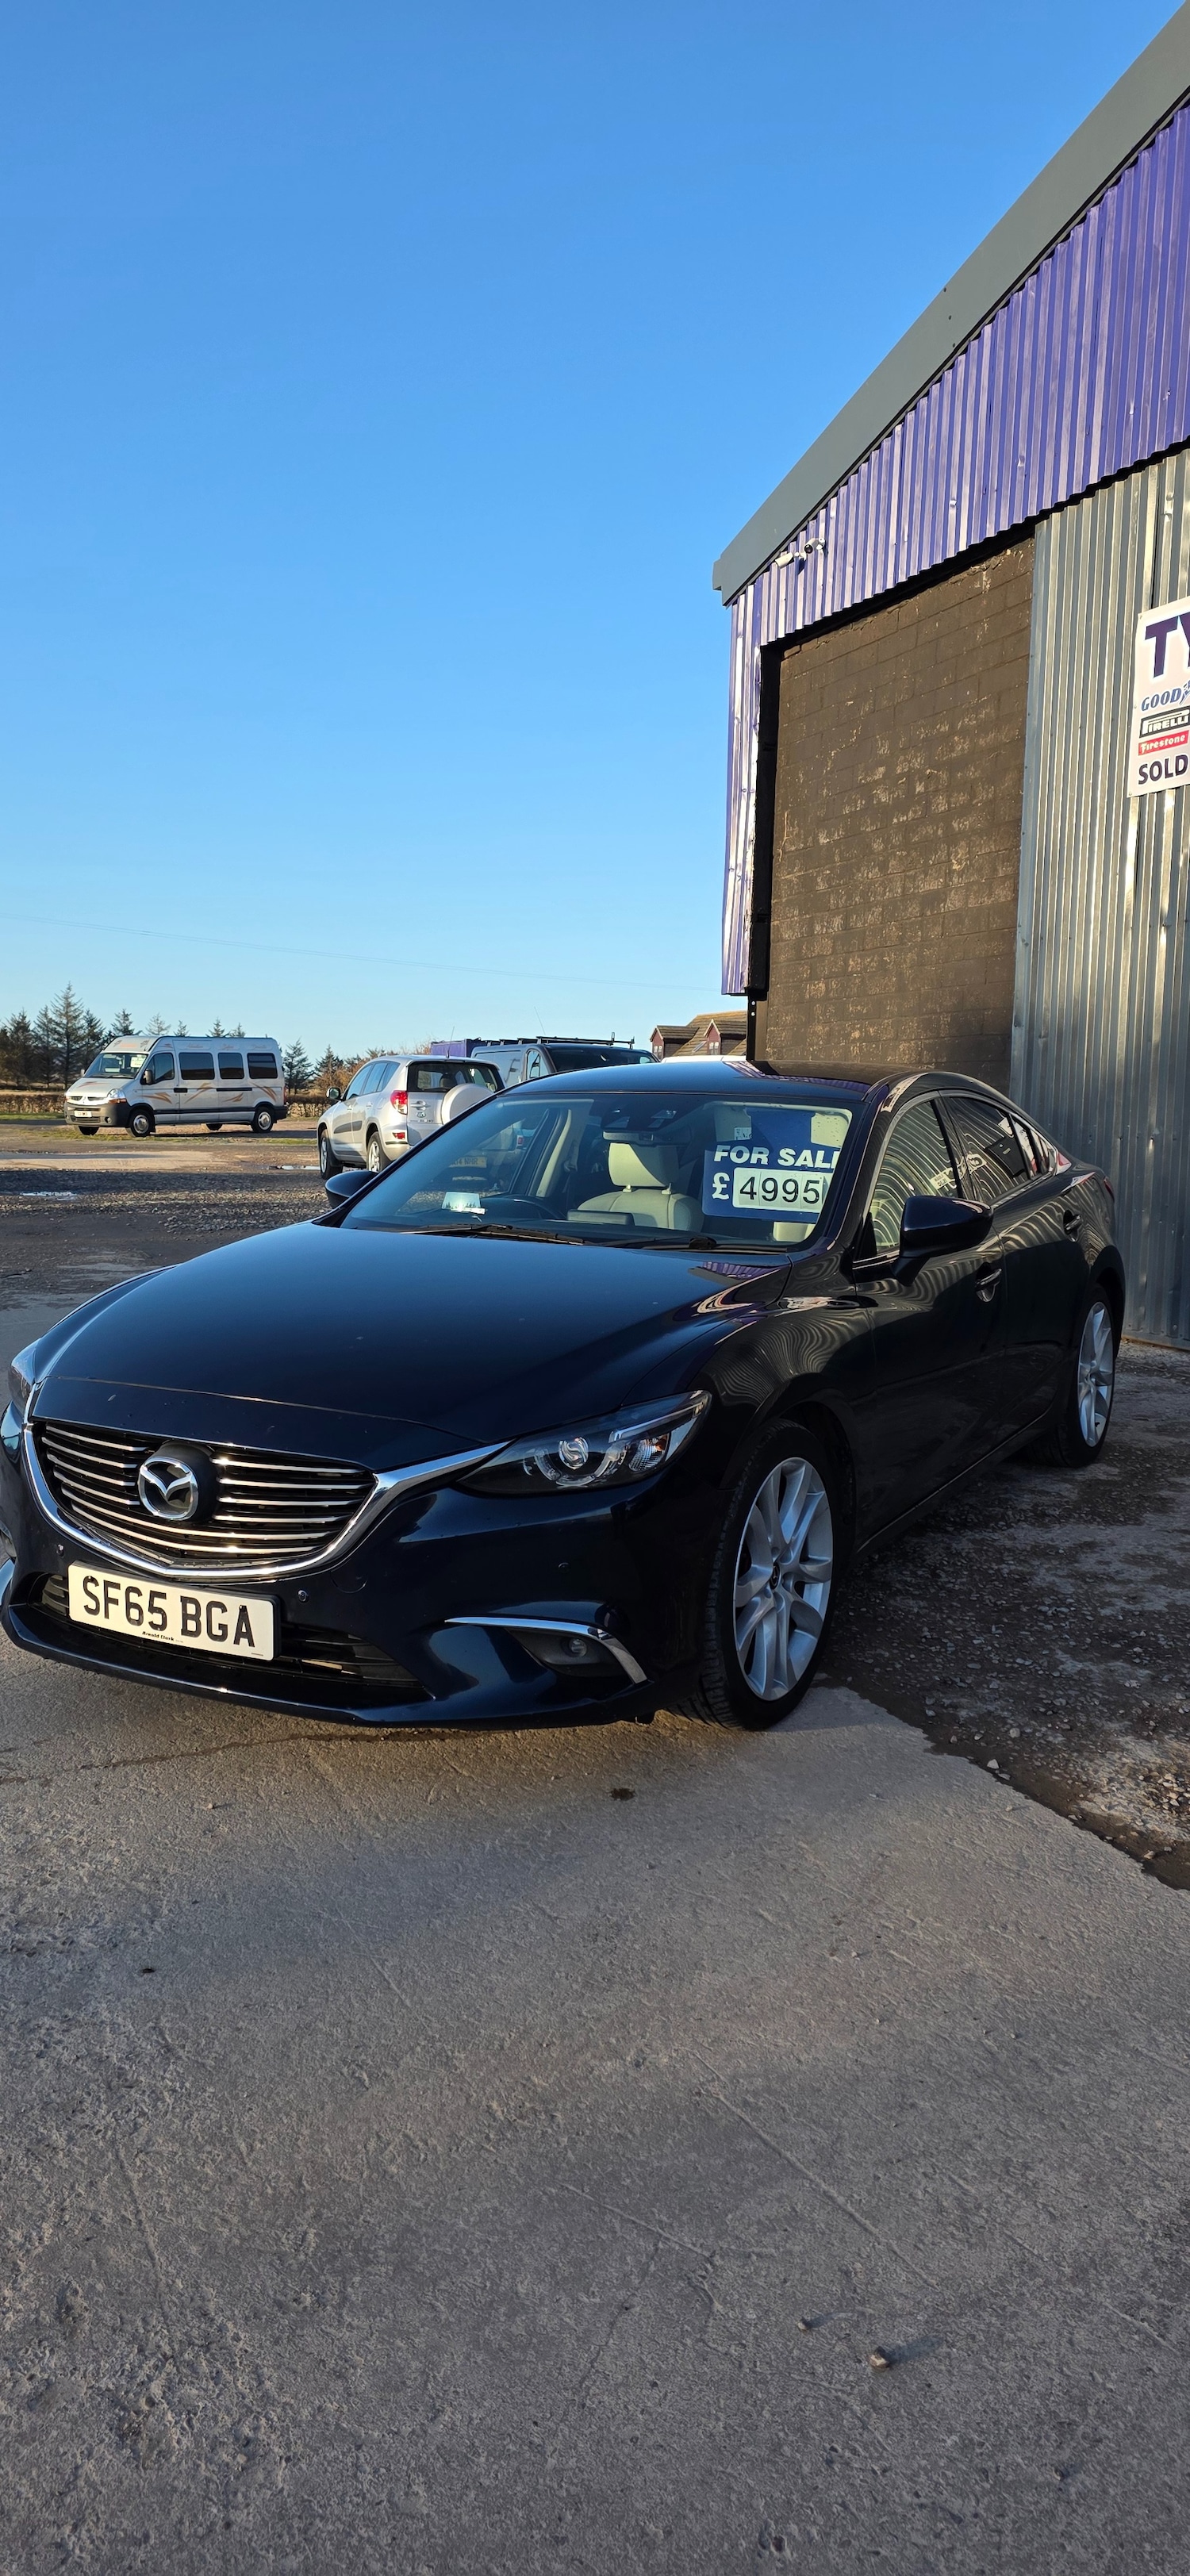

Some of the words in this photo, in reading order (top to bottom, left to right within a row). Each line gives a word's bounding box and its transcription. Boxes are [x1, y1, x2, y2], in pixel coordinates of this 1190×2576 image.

[1142, 708, 1190, 735] PIRELLI
[1140, 735, 1186, 754] Firestone
[1138, 754, 1188, 785] SOLD
[714, 1145, 770, 1165] FOR
[712, 1172, 730, 1200] £
[739, 1177, 820, 1204] 4995
[83, 1576, 167, 1631] SF65
[180, 1595, 255, 1648] BGA
